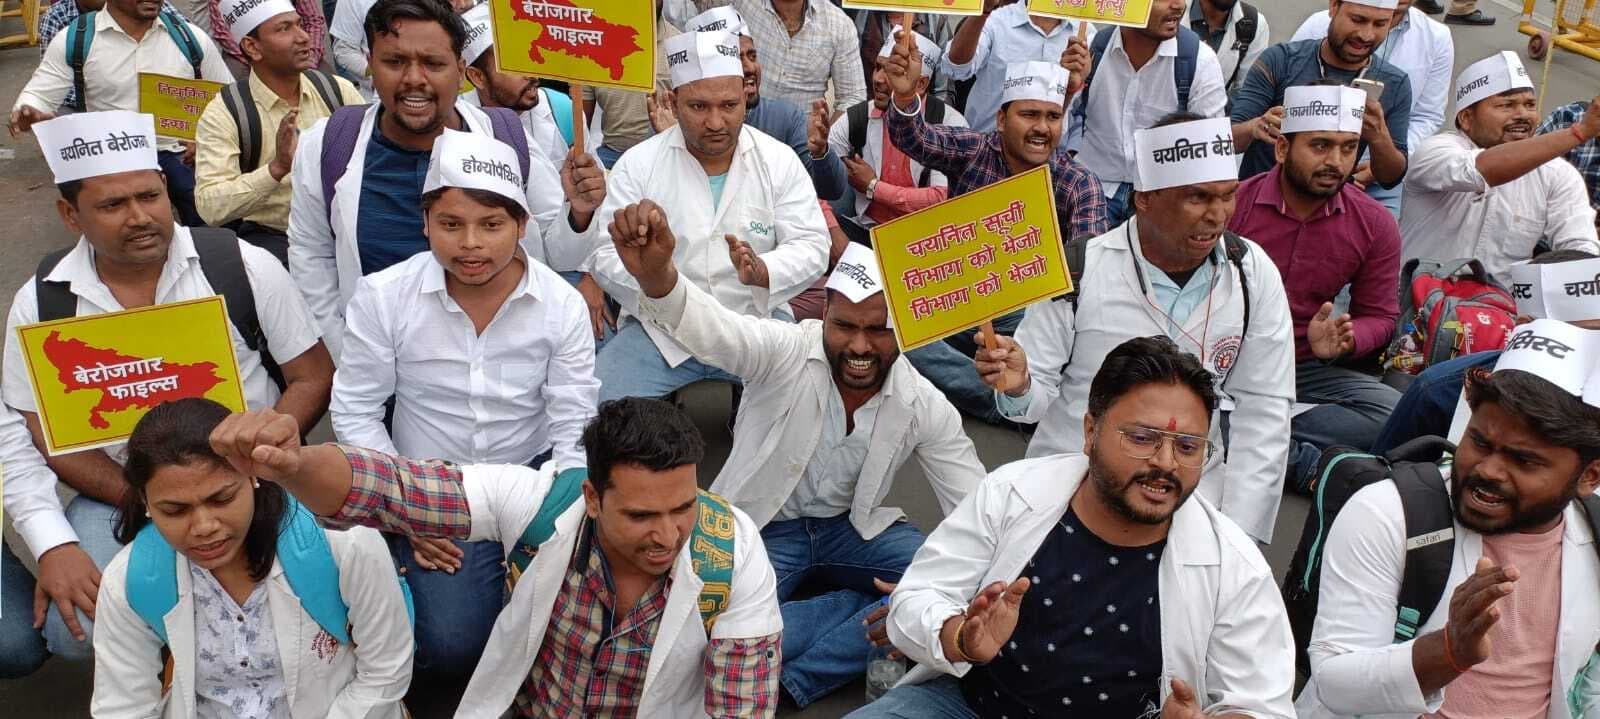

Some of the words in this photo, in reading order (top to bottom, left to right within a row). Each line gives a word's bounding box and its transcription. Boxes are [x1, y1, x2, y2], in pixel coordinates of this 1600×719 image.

[546, 24, 603, 46] फाइल्स
[59, 137, 104, 162] चयनित
[1152, 138, 1208, 164] चयनित
[905, 223, 977, 257] चयनित
[980, 200, 1025, 237] सूची
[902, 258, 963, 292] विभाग
[967, 244, 997, 269] को
[1001, 226, 1042, 255] भेजो
[909, 287, 970, 321] विभाग
[974, 272, 1003, 296] को
[1007, 254, 1047, 284] भेजो
[73, 356, 164, 385] बेरोजगार
[107, 375, 179, 400] फाइल्स
